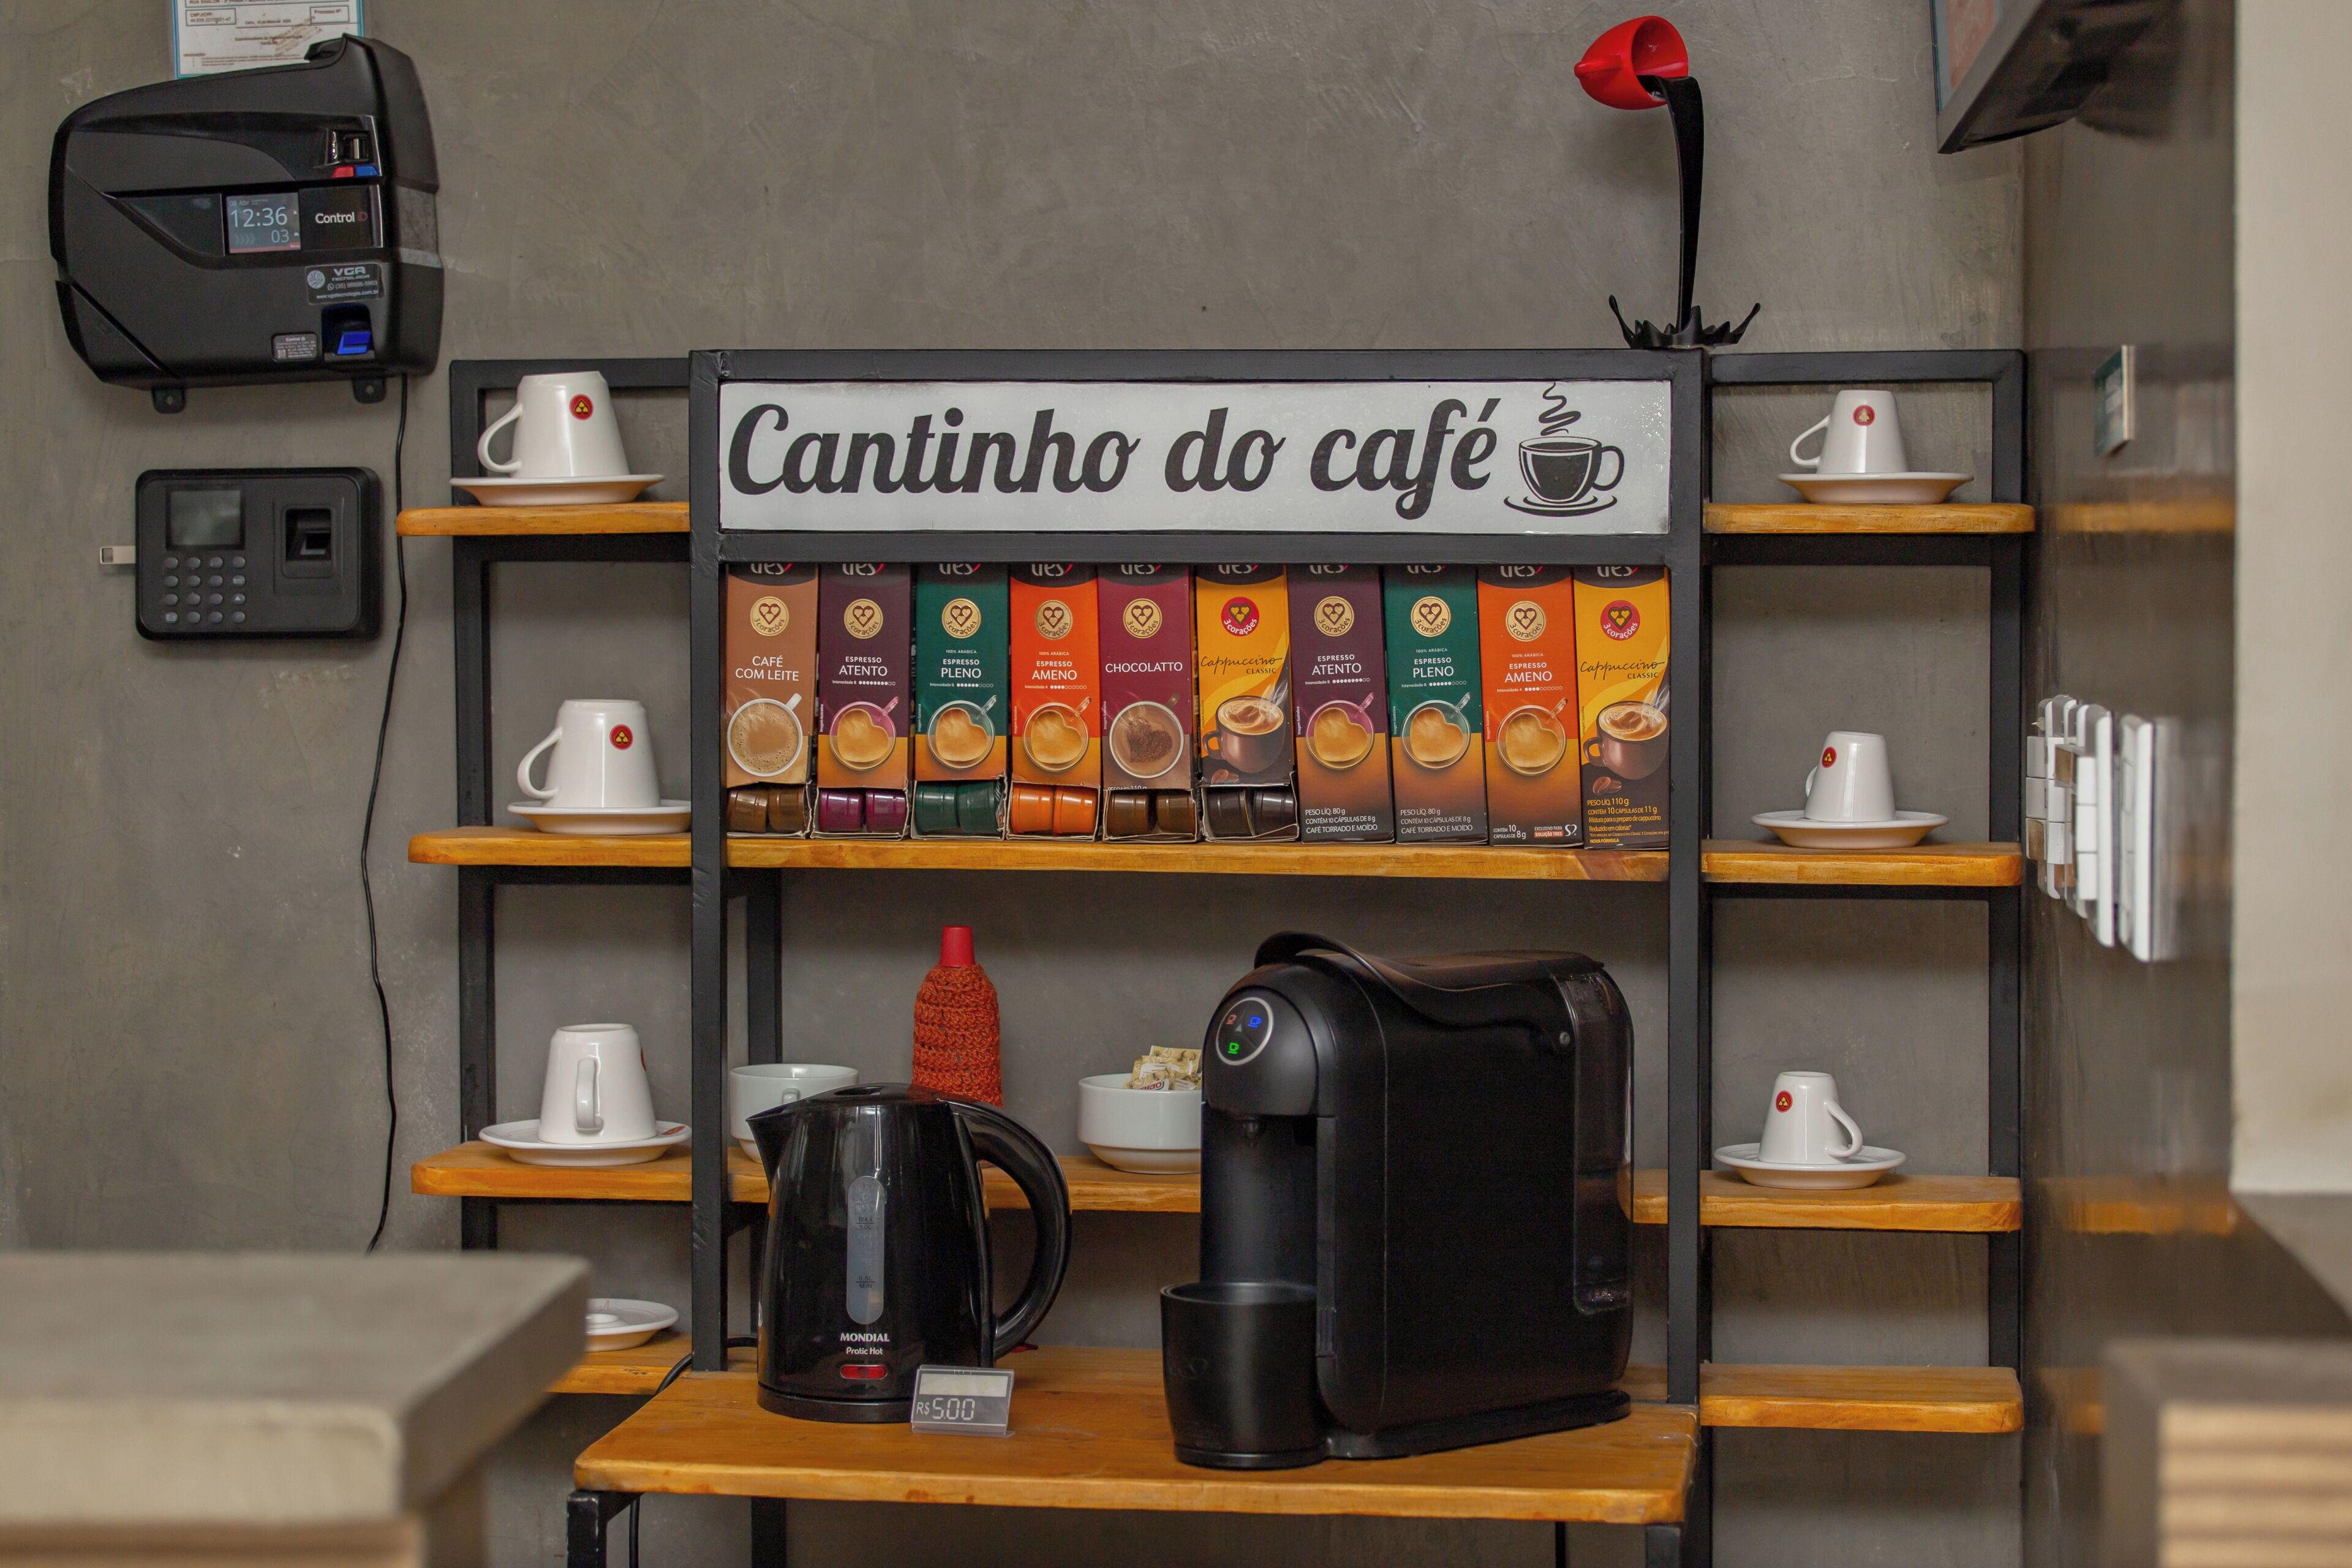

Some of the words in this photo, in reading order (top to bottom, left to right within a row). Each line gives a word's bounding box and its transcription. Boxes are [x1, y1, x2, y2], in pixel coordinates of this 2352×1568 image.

[231, 207, 287, 228] 12:36
[315, 212, 355, 224] Control
[271, 230, 289, 243] 03
[729, 404, 1140, 495] Cantinho
[1165, 407, 1286, 492] do
[1310, 398, 1501, 521] café
[756, 619, 785, 633] corações
[850, 621, 879, 636] corações
[948, 620, 977, 635] corações
[1041, 622, 1069, 637] corações
[1130, 620, 1158, 635] corações
[1227, 619, 1257, 635] corações
[1322, 617, 1351, 633] corações
[1418, 617, 1447, 633] corações
[1513, 622, 1542, 638] corações
[1607, 622, 1638, 639] corações
[752, 655, 783, 667] CAFÉ
[1105, 662, 1183, 673] CHOCOLATTO
[1200, 655, 1283, 675] Cappuccino
[735, 668, 764, 679] COM
[767, 670, 799, 681] LEITE
[839, 665, 888, 676] ATENTO
[941, 668, 981, 679] PLENO
[1031, 669, 1077, 680] AMENO
[1312, 663, 1362, 676] ATENTO
[1413, 666, 1454, 678] PLENO
[1580, 659, 1665, 680] Cappuccino
[1504, 671, 1553, 683] AMENO
[1321, 807, 1332, 816] LÍQ.
[1508, 824, 1517, 832] 10
[840, 1333, 890, 1342] MONDIAL
[916, 1401, 930, 1415] R$
[932, 1397, 975, 1420] 5.00
